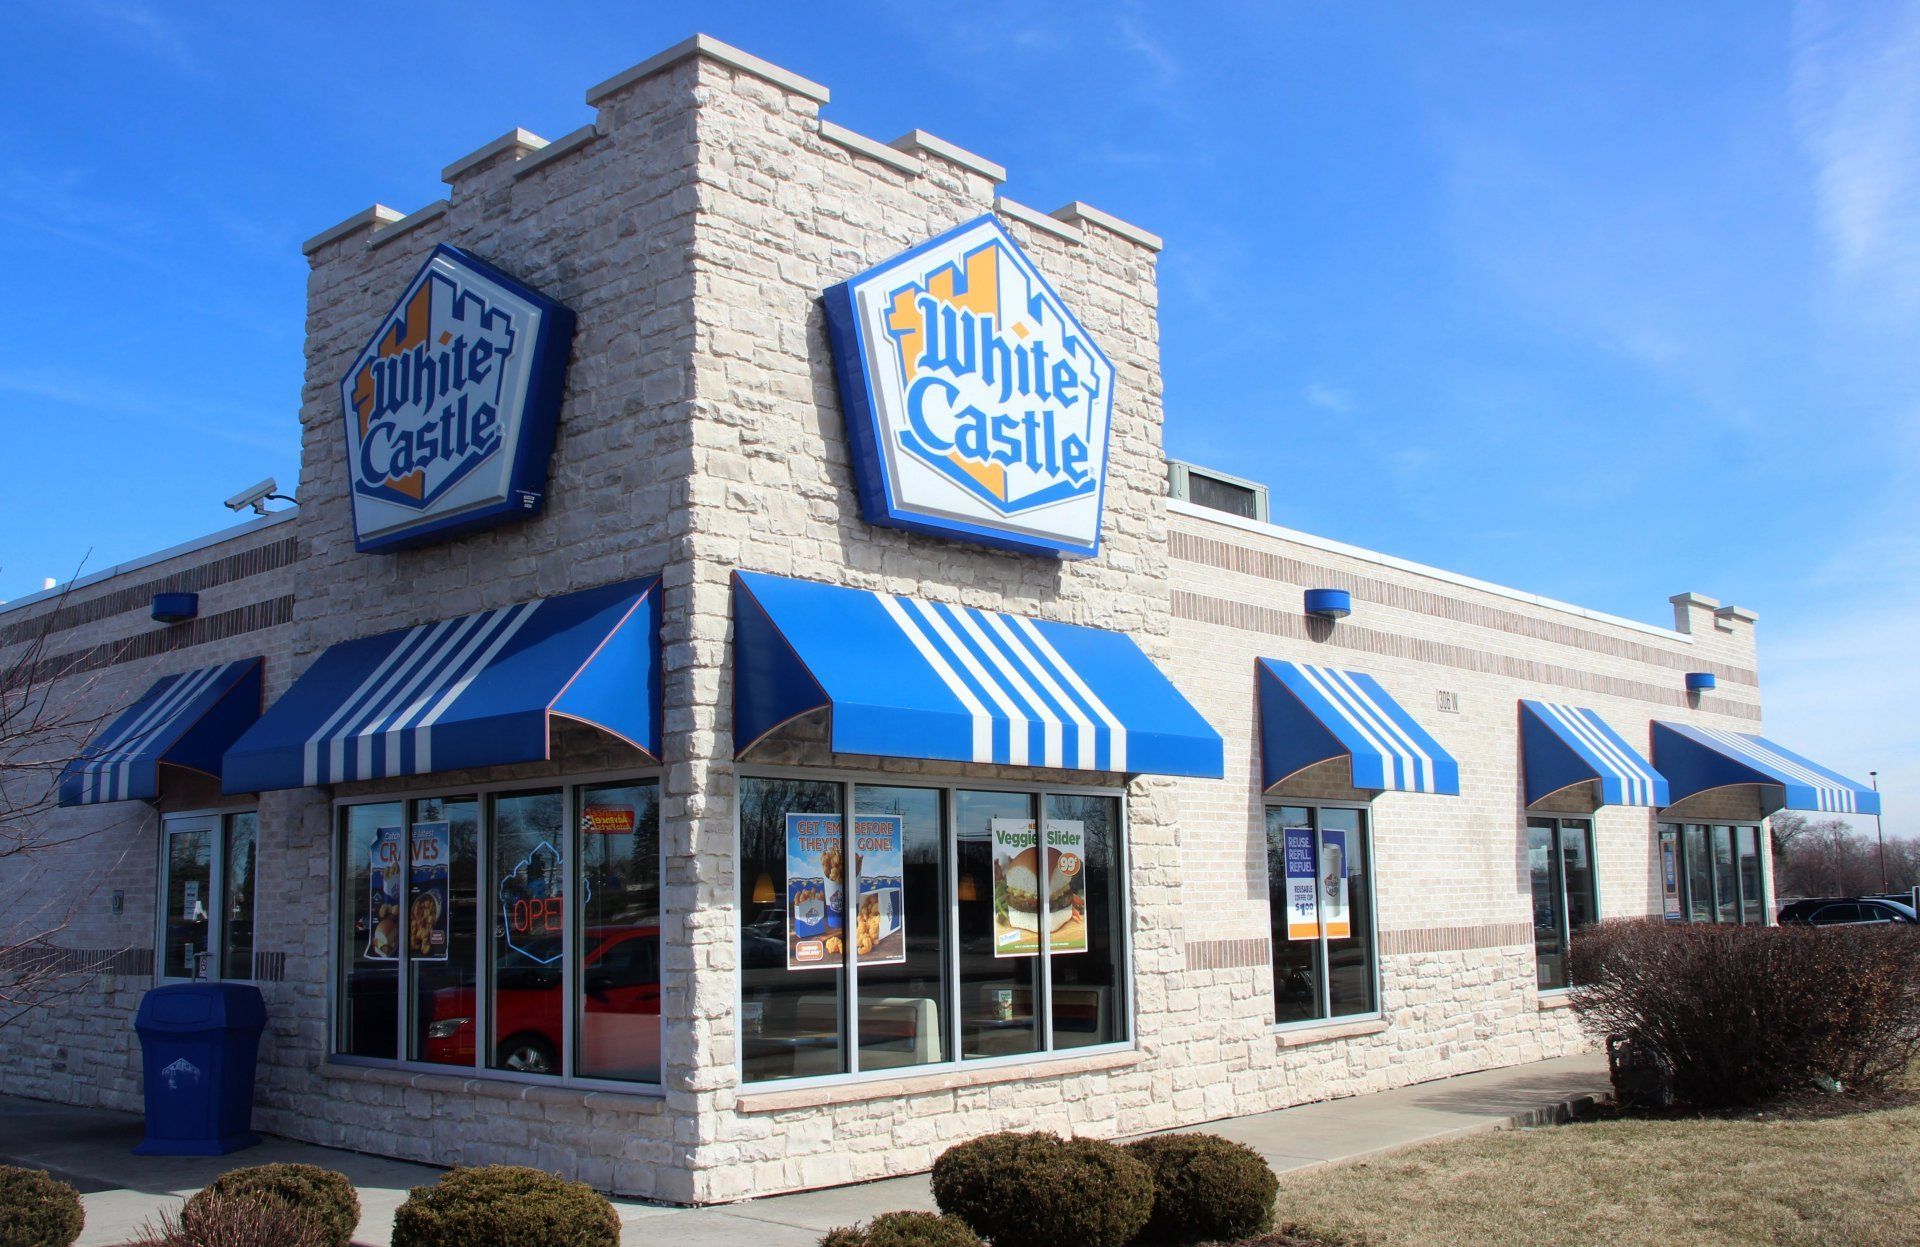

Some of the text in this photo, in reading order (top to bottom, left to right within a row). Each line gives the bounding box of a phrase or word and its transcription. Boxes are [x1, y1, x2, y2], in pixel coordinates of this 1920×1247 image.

[917, 298, 1079, 408] White
[368, 334, 494, 421] White
[360, 393, 497, 484] Castle
[907, 376, 1088, 483] Castle
[797, 821, 819, 835] GET
[1046, 831, 1081, 846] Slider
[380, 838, 439, 862] CRVES
[798, 837, 842, 851] THEY'R
[857, 838, 893, 851] GONE!
[514, 896, 563, 932] OPE
